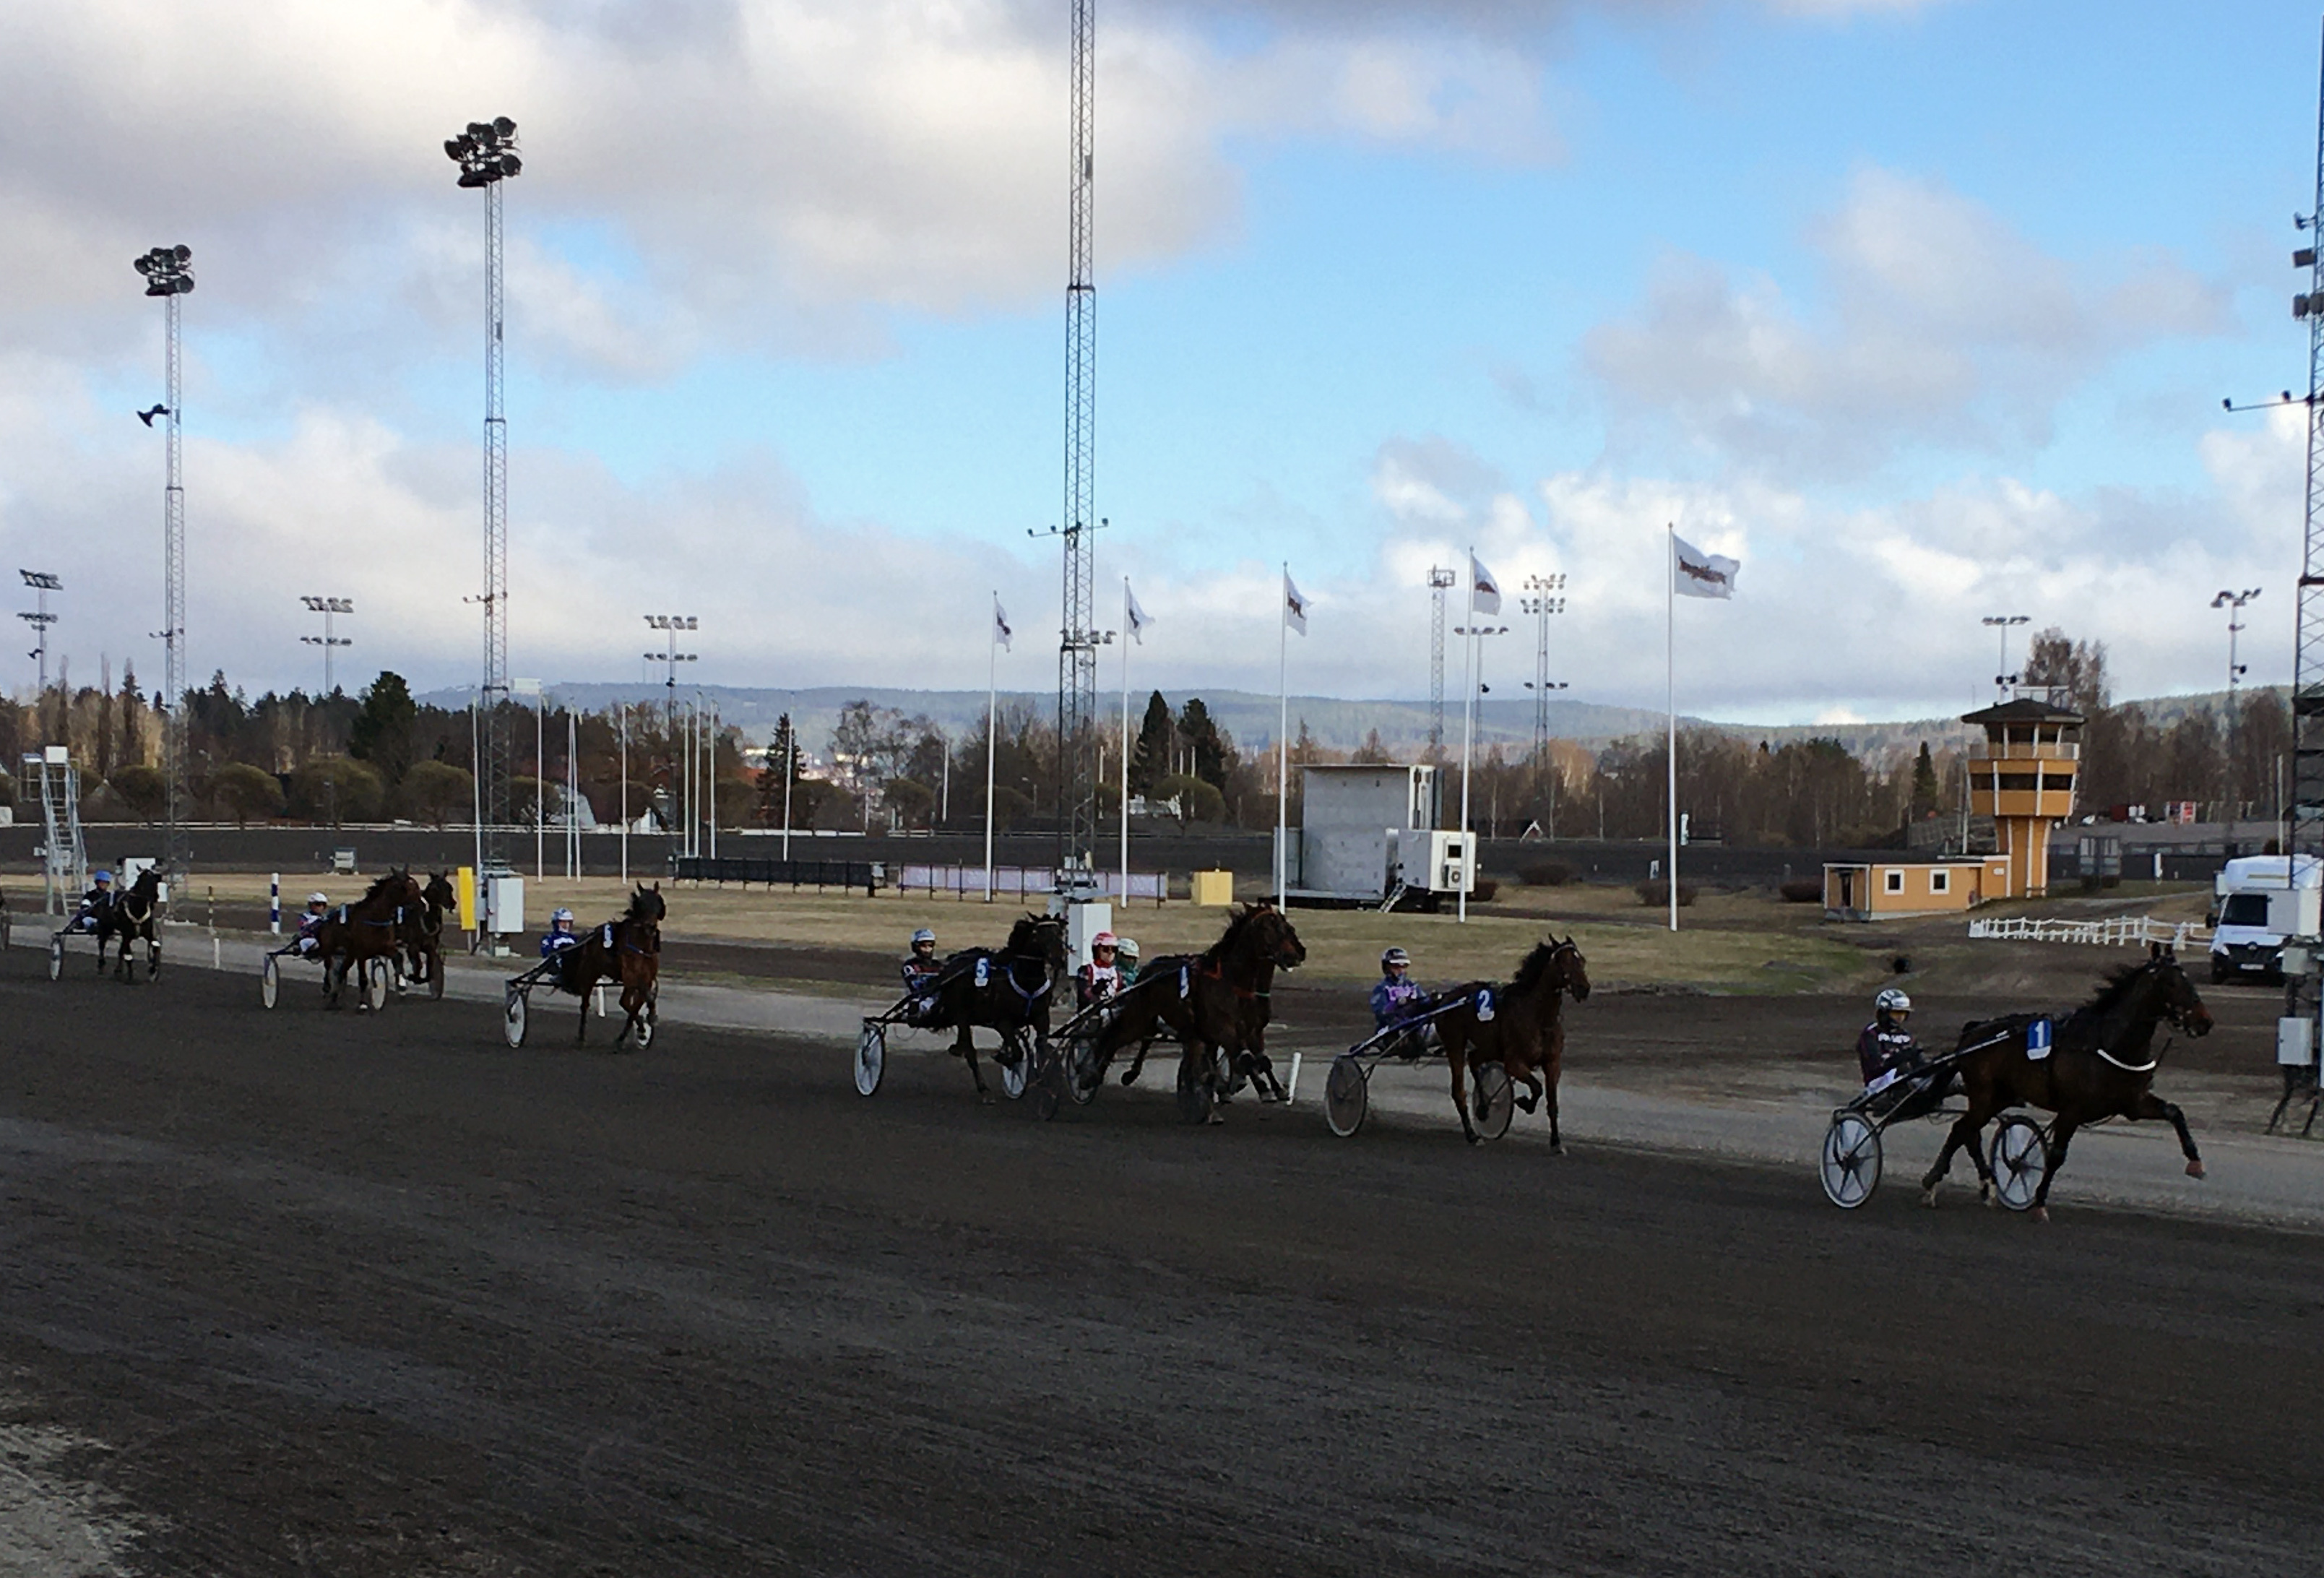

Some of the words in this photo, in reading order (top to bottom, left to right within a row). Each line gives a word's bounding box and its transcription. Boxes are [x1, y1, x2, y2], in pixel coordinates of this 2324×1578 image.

[977, 958, 987, 978] 5
[1479, 990, 1490, 1013] 2
[2034, 1021, 2044, 1047] 1
